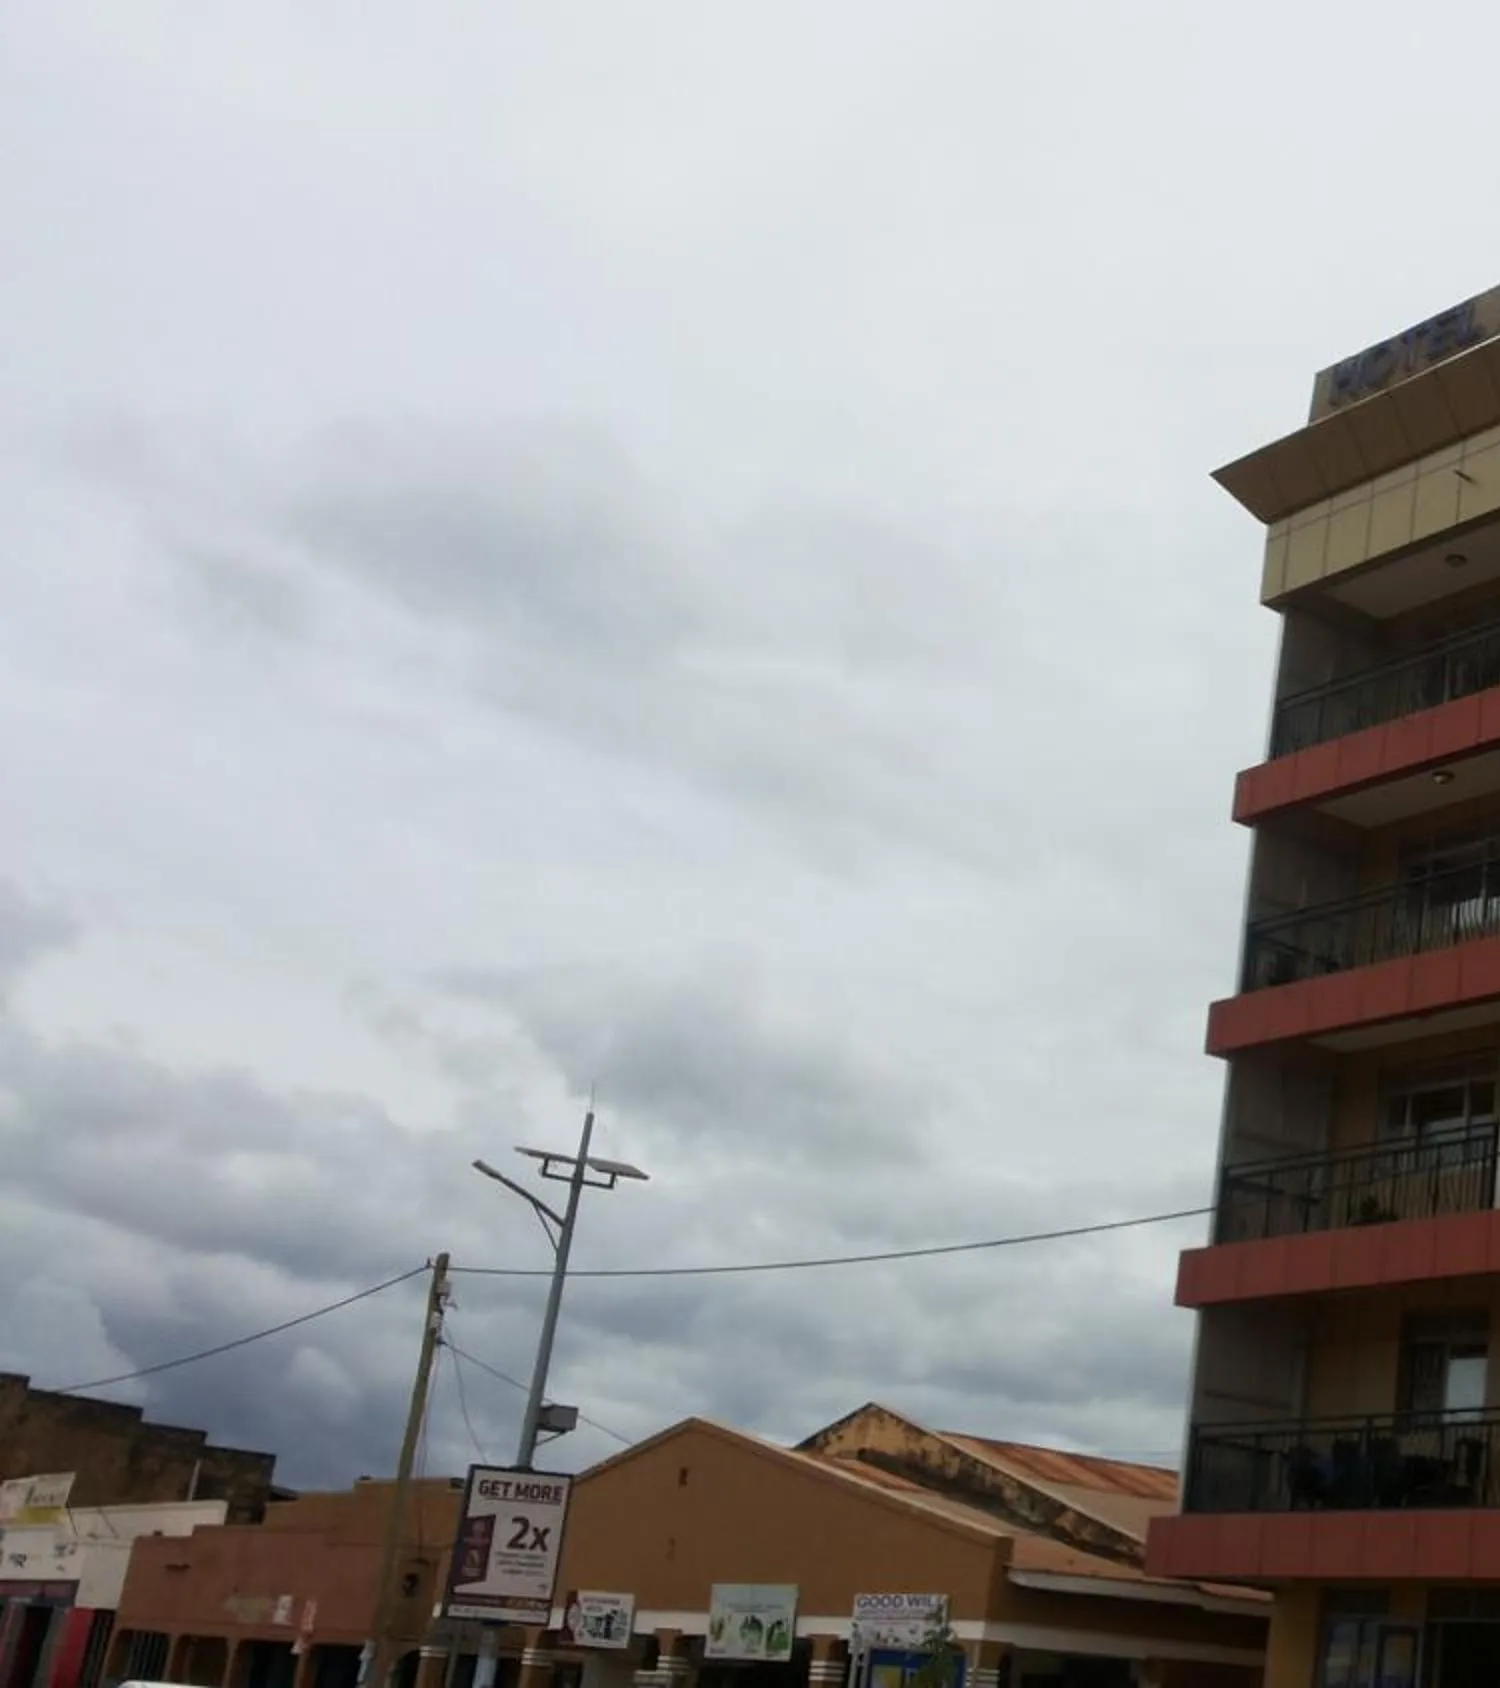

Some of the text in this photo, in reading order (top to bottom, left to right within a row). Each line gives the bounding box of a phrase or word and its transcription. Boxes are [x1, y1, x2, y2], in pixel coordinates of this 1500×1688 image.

[1328, 303, 1486, 404] HOTEL
[477, 1478, 563, 1501] GET MORE
[506, 1516, 551, 1551] 2x
